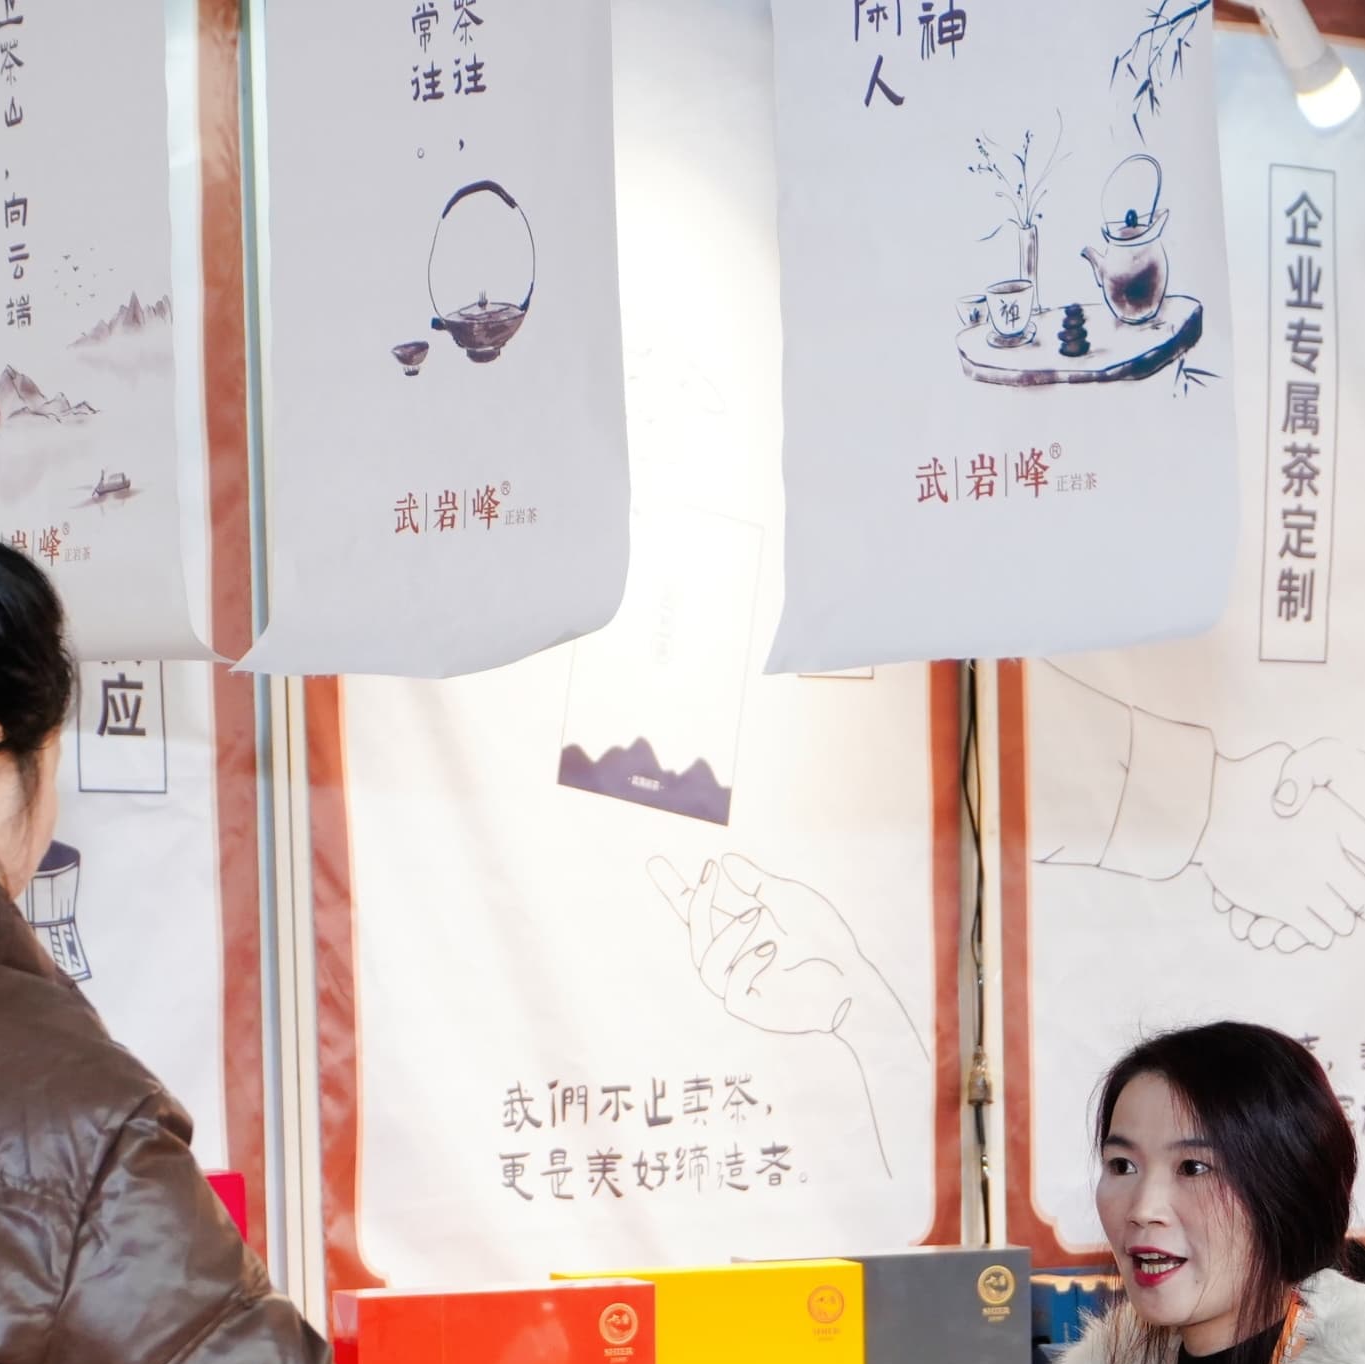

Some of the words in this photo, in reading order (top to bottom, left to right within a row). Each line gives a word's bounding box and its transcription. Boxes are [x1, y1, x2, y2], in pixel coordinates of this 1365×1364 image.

[1277, 190, 1324, 623] 企业专属茶定制
